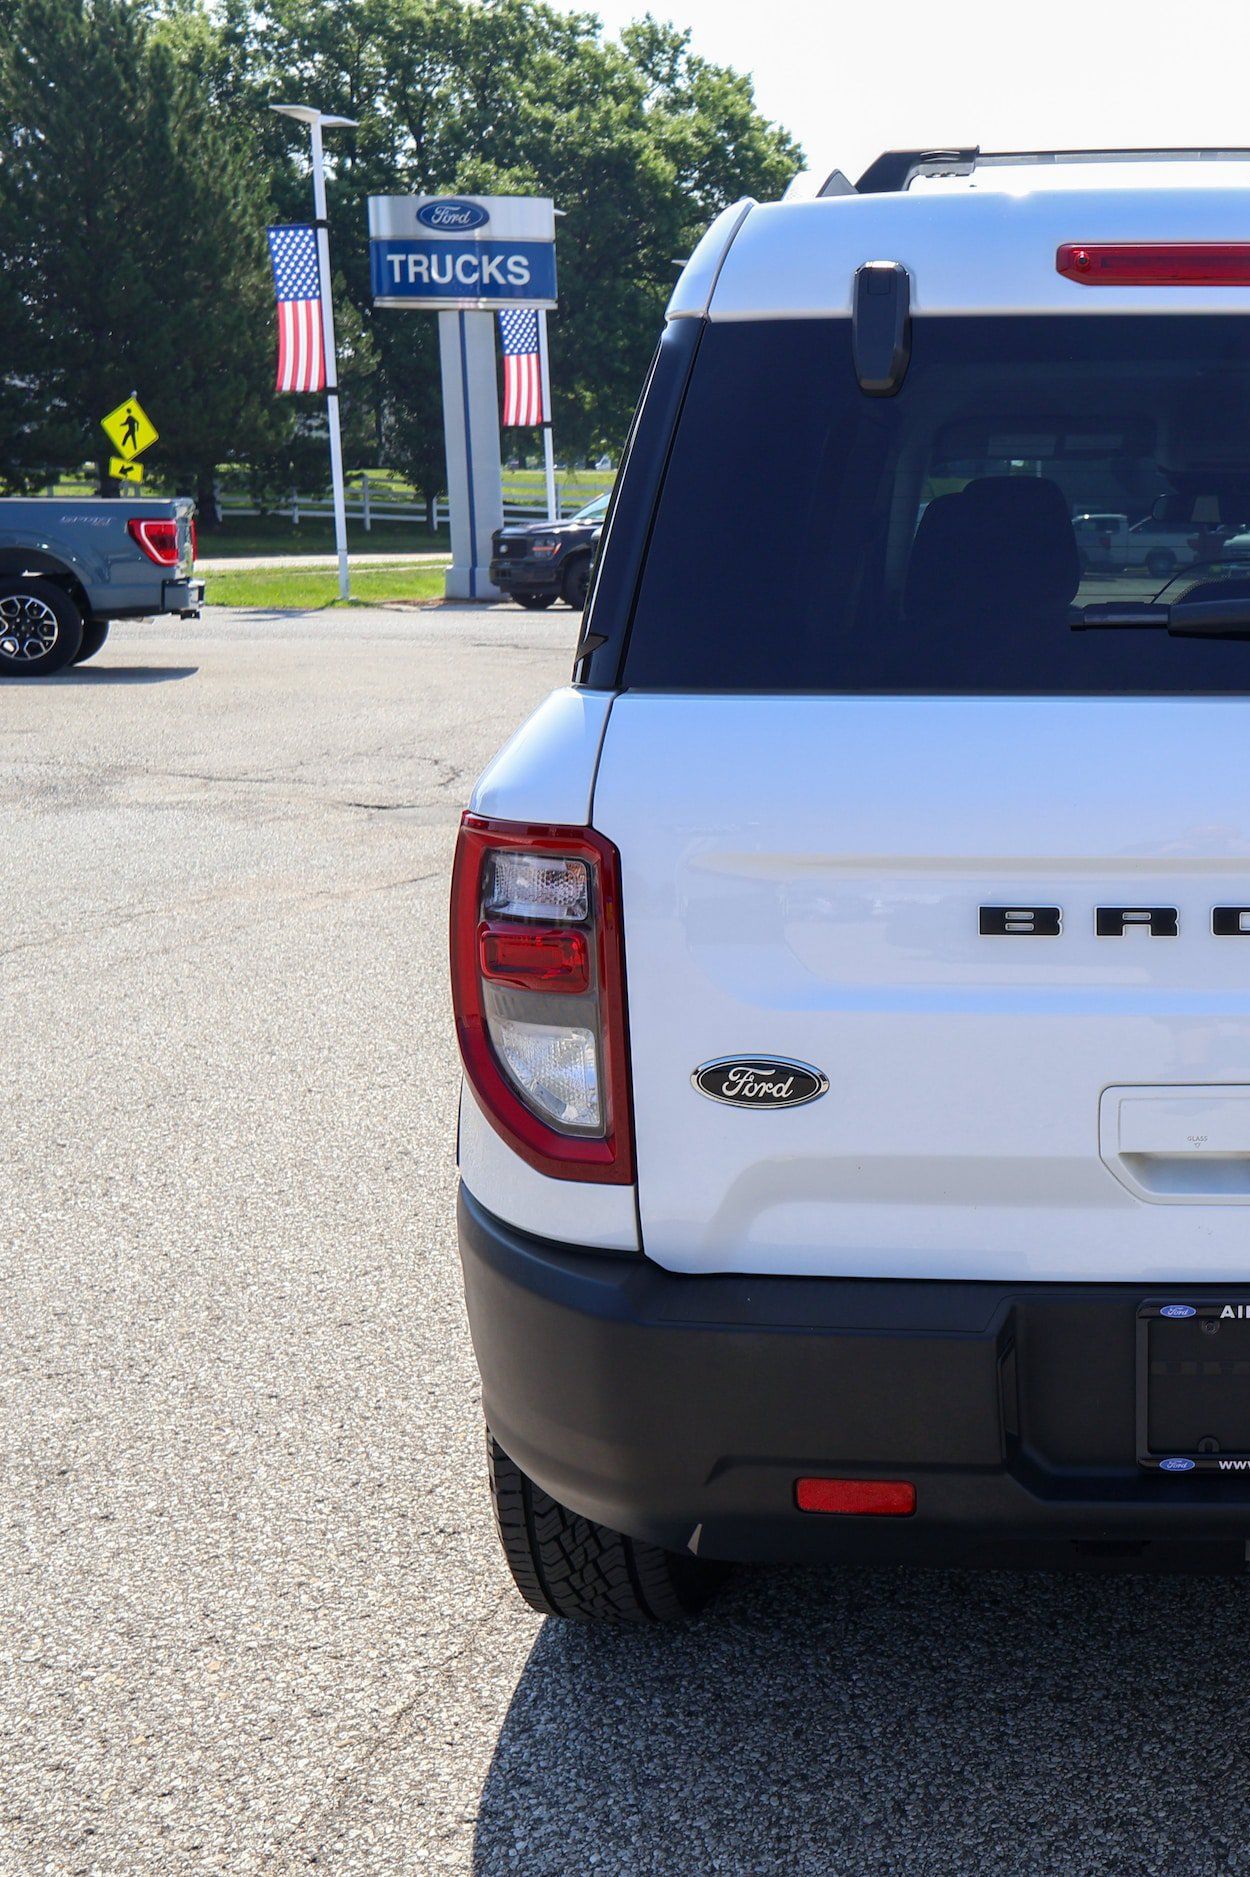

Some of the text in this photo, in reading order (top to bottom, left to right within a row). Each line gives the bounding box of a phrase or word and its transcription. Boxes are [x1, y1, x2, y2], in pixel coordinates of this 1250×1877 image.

[431, 206, 470, 224] Ford
[386, 254, 531, 286] TRUCKS
[721, 1066, 796, 1098] Ford
